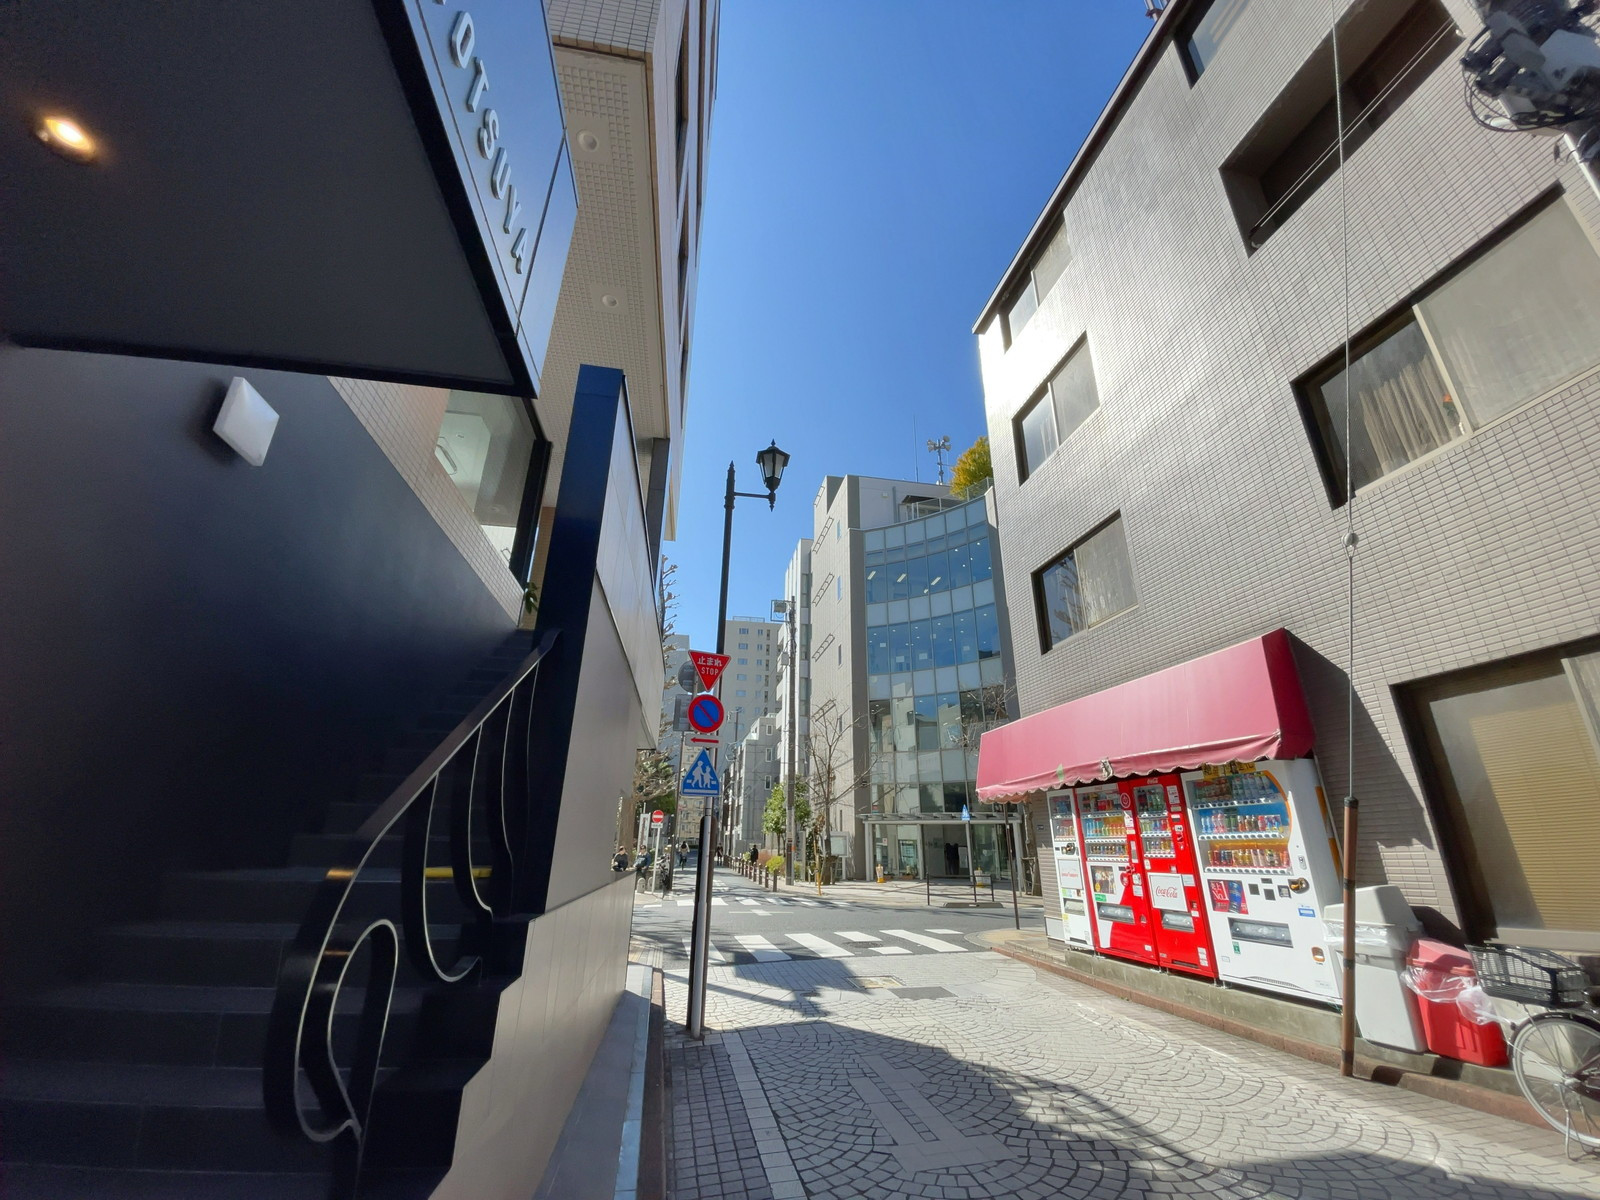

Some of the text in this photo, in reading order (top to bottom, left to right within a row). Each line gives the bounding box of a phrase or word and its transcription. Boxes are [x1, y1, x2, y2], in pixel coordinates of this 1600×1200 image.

[434, 0, 529, 274] OTSUYA
[697, 656, 722, 666] 止まれ
[701, 667, 719, 676] STOP
